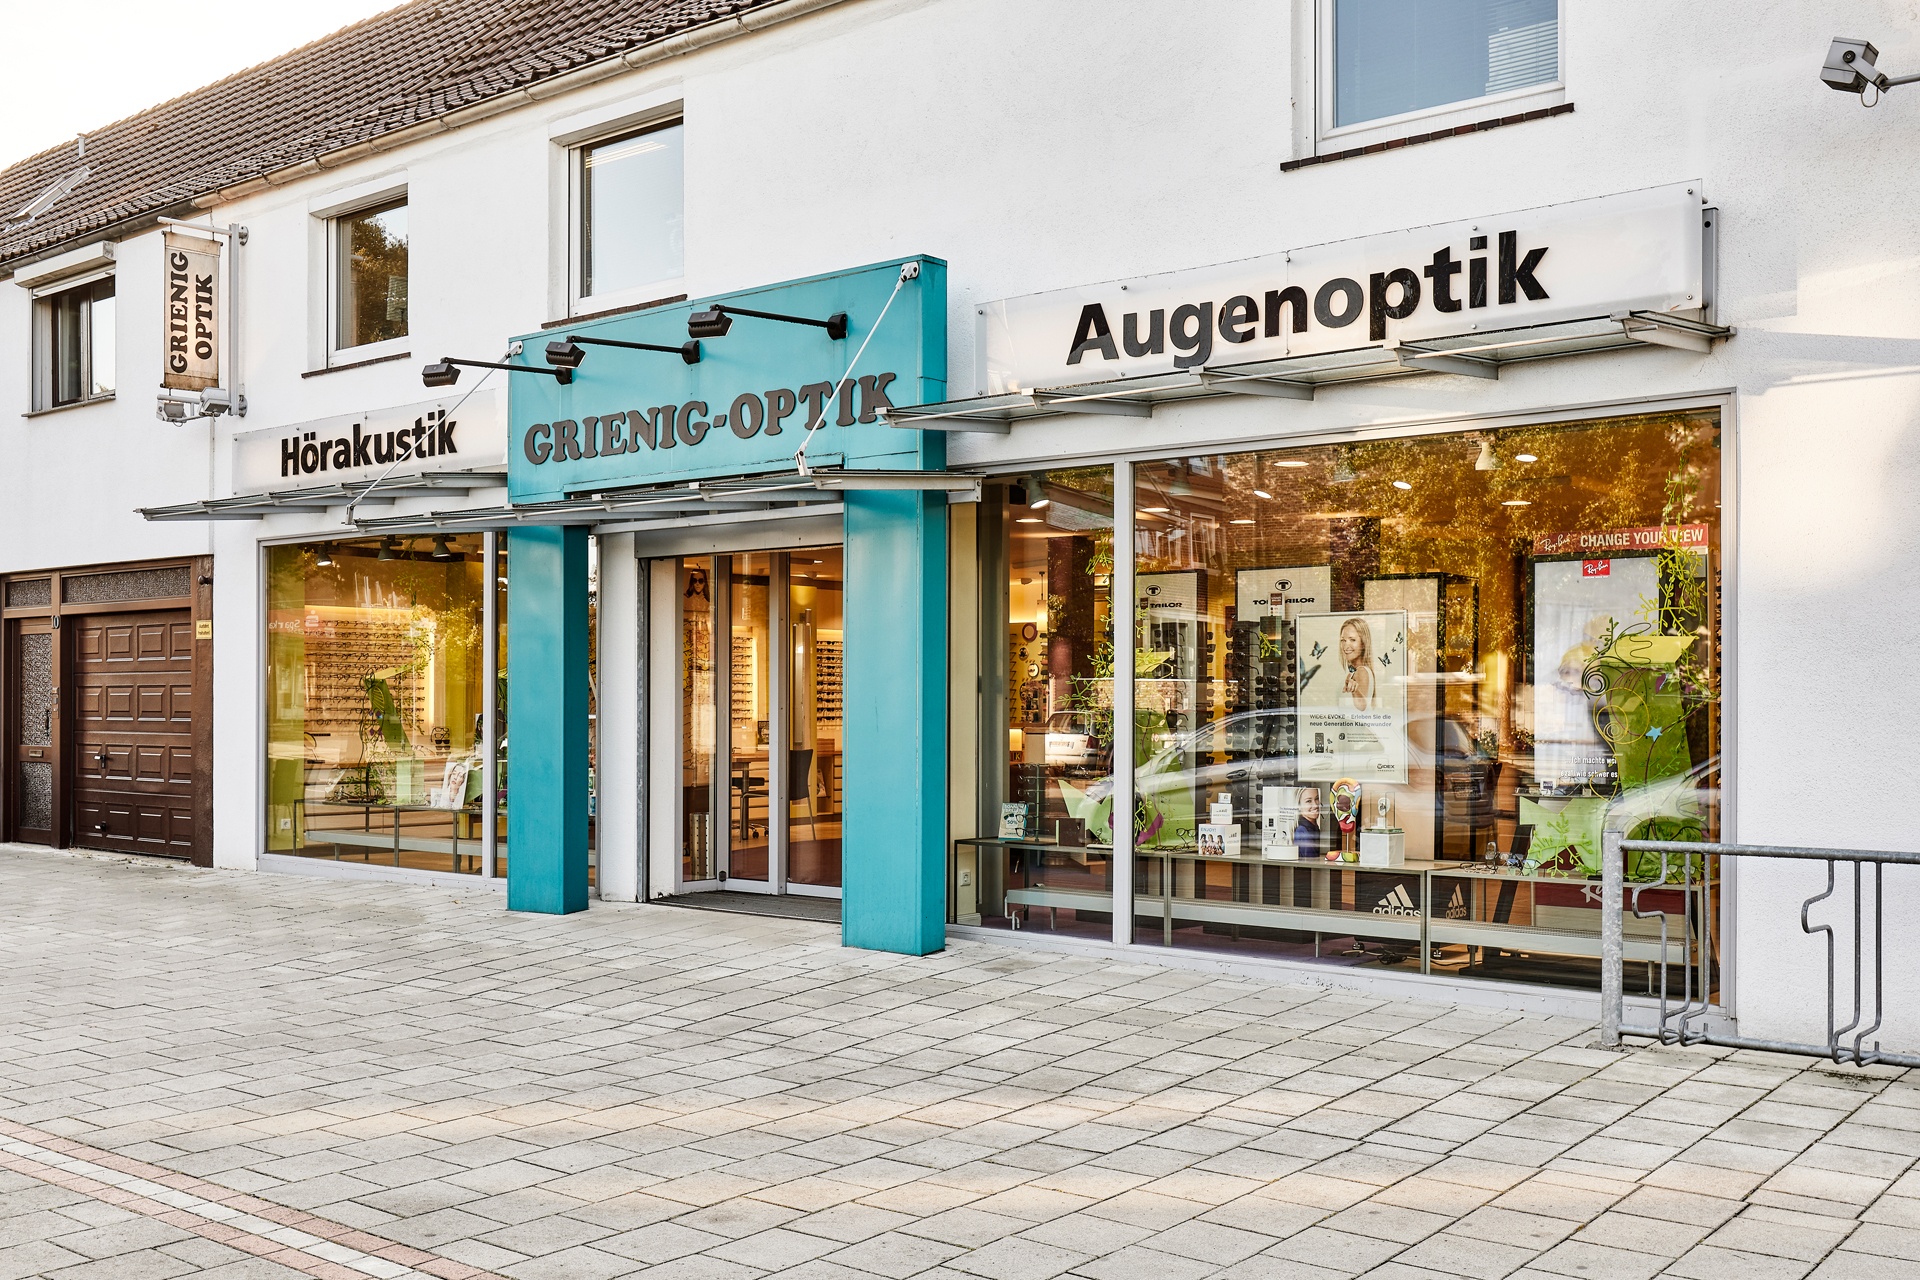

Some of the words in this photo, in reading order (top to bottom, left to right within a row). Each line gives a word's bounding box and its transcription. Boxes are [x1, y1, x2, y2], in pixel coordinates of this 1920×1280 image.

[170, 251, 189, 374] GRIENIG
[195, 274, 212, 360] OPTIK
[1066, 230, 1550, 369] Augenoptik
[281, 409, 458, 477] Hörakustik
[524, 372, 897, 465] GRIENIG-OPTIK
[1580, 532, 1630, 547] CHANGE
[1583, 560, 1609, 574] Ray-Ban
[1445, 904, 1467, 920] adidas
